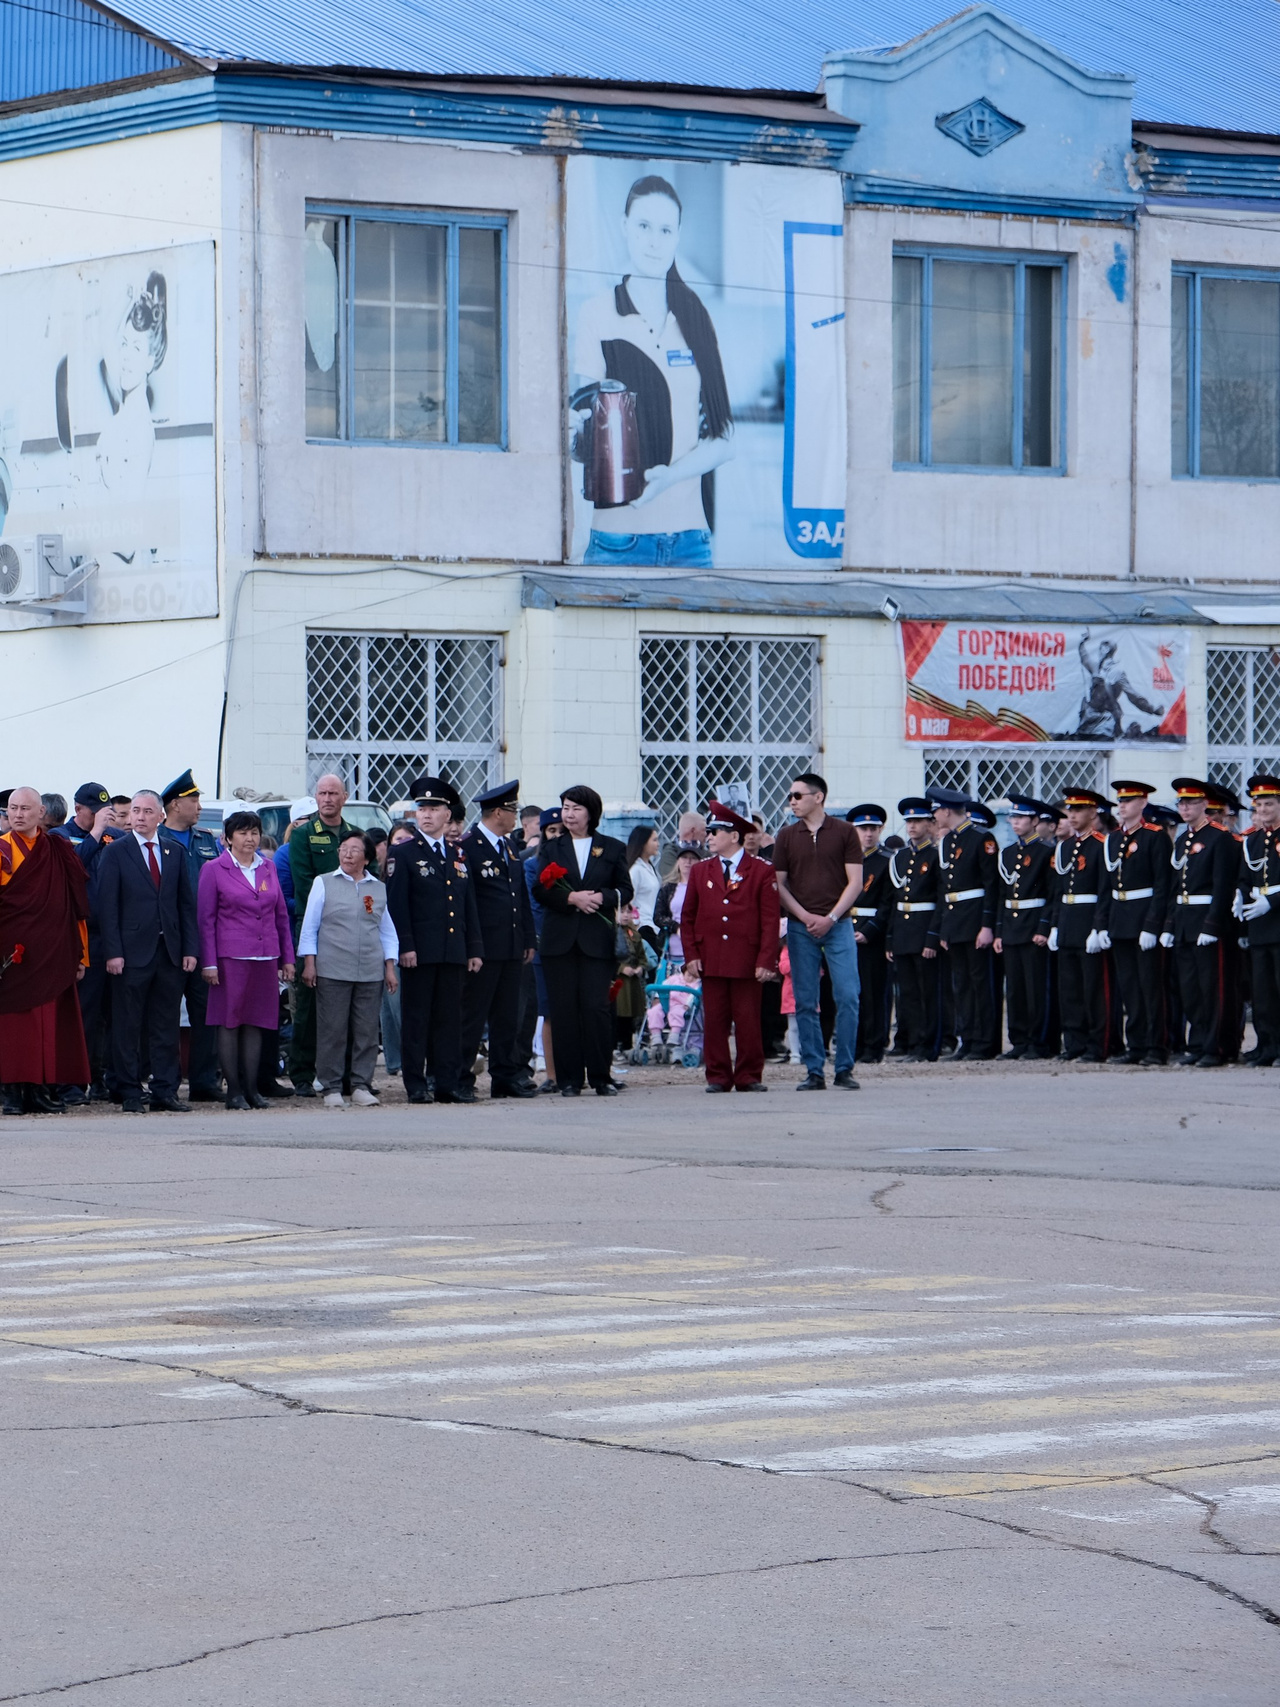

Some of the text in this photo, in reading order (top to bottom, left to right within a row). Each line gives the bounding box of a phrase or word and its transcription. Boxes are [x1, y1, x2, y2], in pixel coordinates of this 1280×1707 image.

[958, 629, 1066, 661] ГОРДИМСЯ
[958, 662, 1056, 696] ПОБЕДОЙ!
[908, 714, 917, 736] 9
[921, 717, 951, 736] мая
